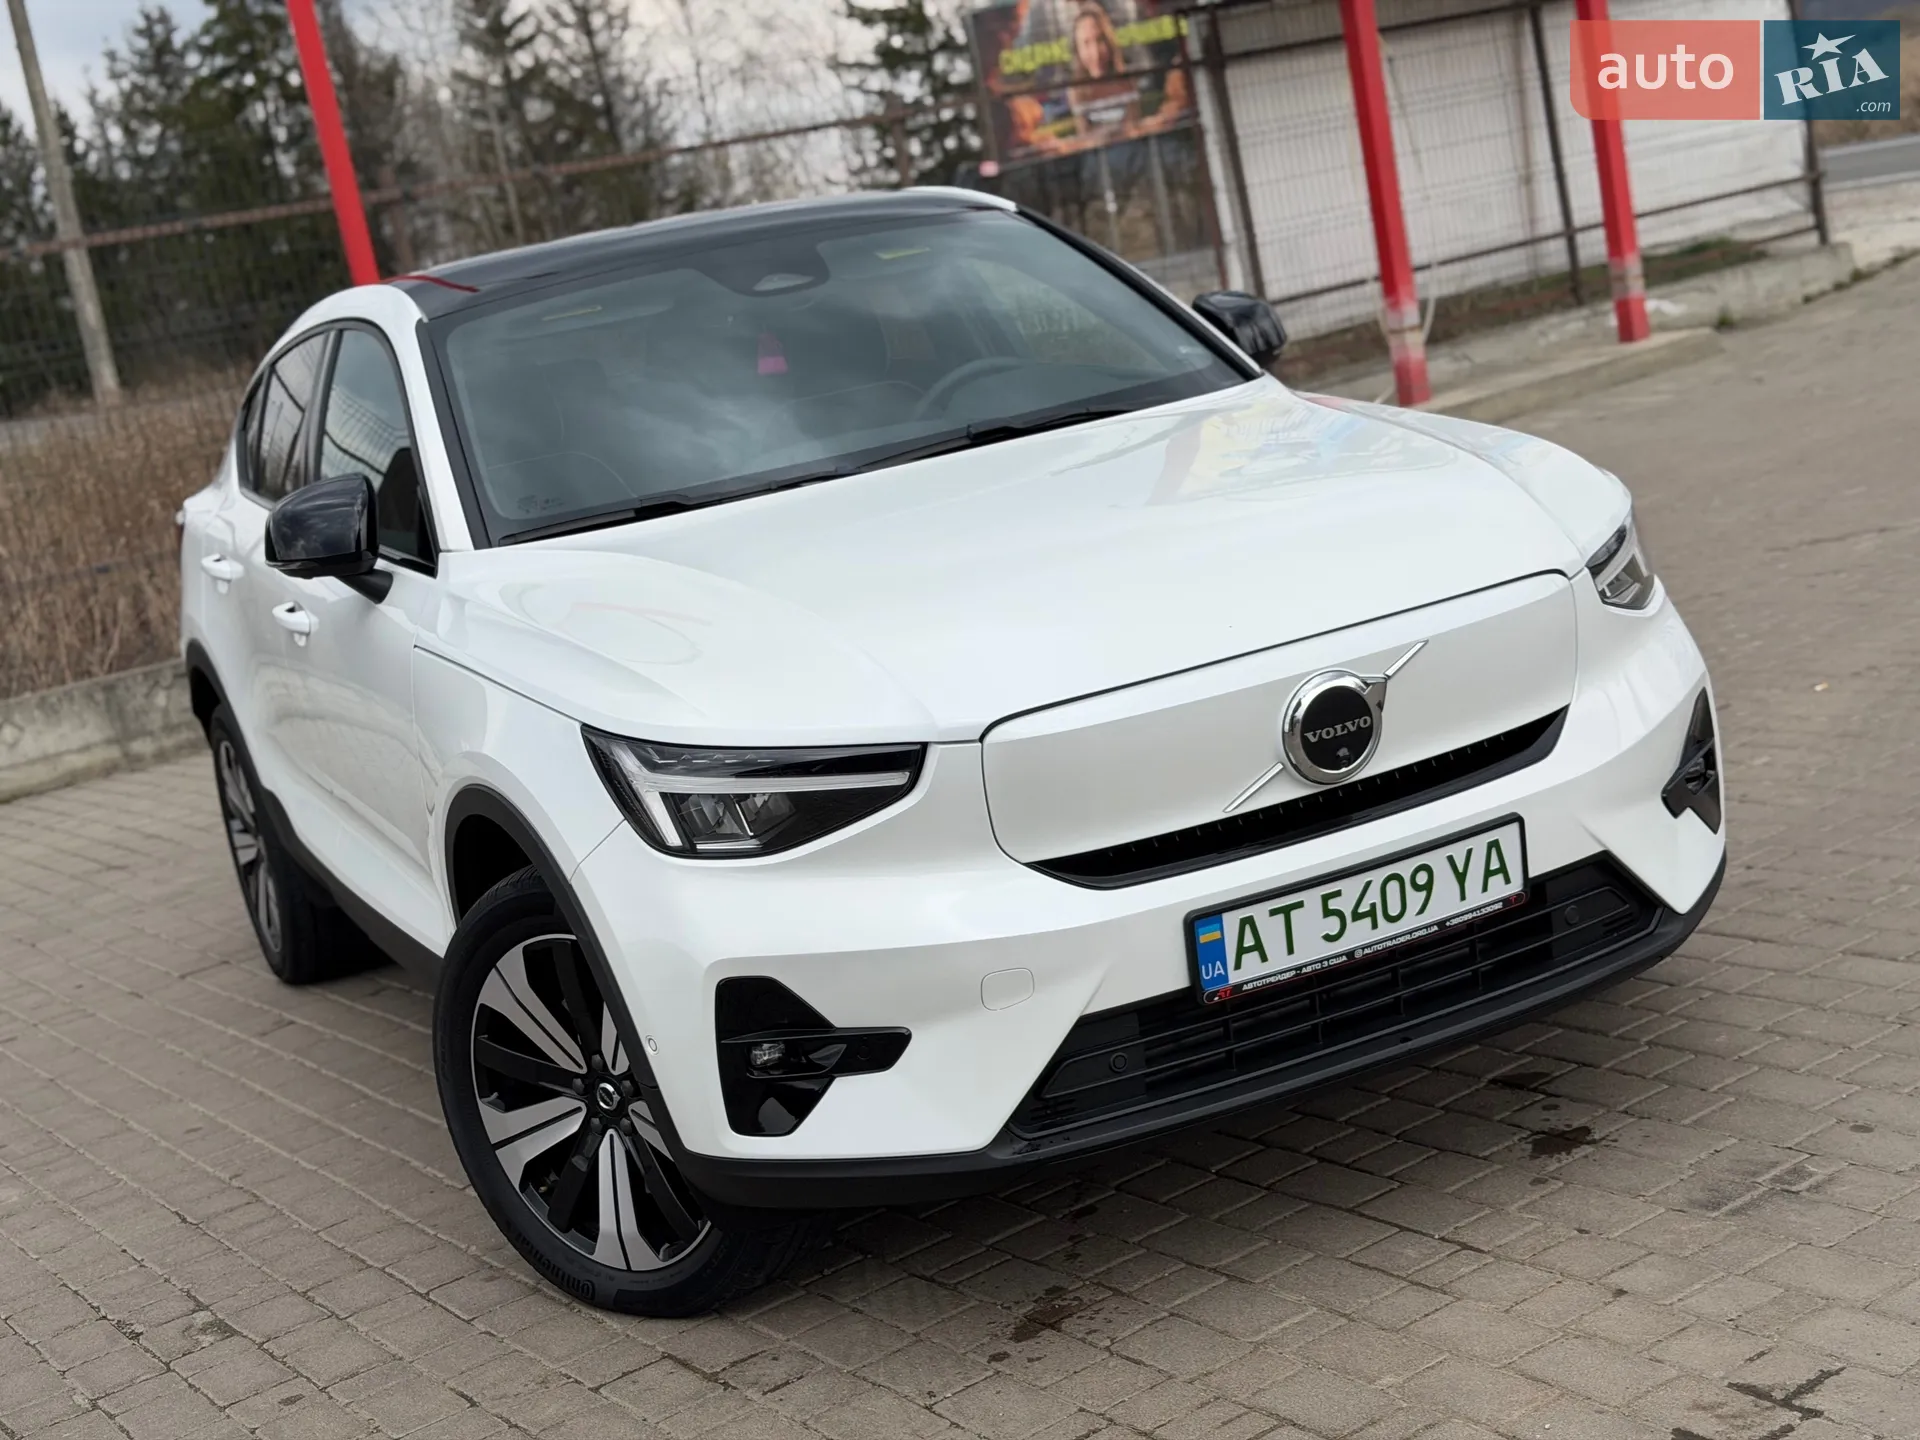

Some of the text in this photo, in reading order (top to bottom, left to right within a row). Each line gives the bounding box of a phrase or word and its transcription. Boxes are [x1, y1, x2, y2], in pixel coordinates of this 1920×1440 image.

[1304, 716, 1371, 743] VOLVO
[1233, 837, 1512, 972] AT 5409 YA
[1202, 960, 1225, 980] UA
[1242, 970, 1296, 991] АВТОТРЕЙДЕР
[1301, 963, 1321, 974] АВТО
[1329, 955, 1348, 966] США
